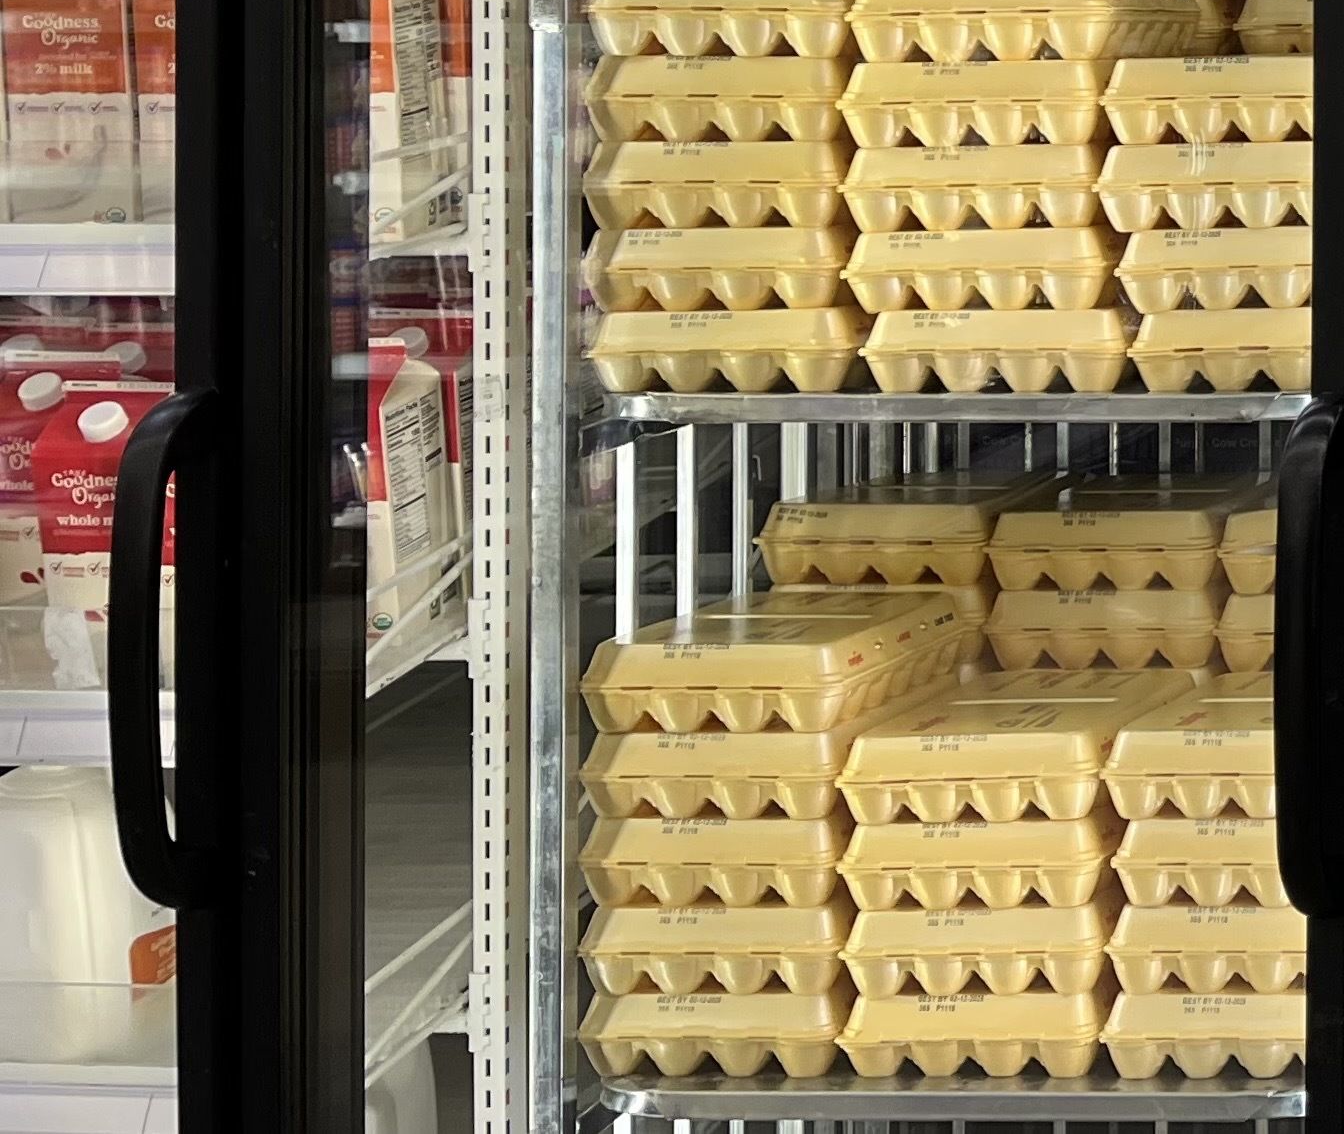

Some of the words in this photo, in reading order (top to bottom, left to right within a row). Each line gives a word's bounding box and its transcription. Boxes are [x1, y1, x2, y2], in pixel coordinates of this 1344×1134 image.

[22, 14, 100, 30] Goodness
[40, 28, 98, 50] Organic
[59, 62, 94, 74] milk
[56, 514, 100, 526] whole
